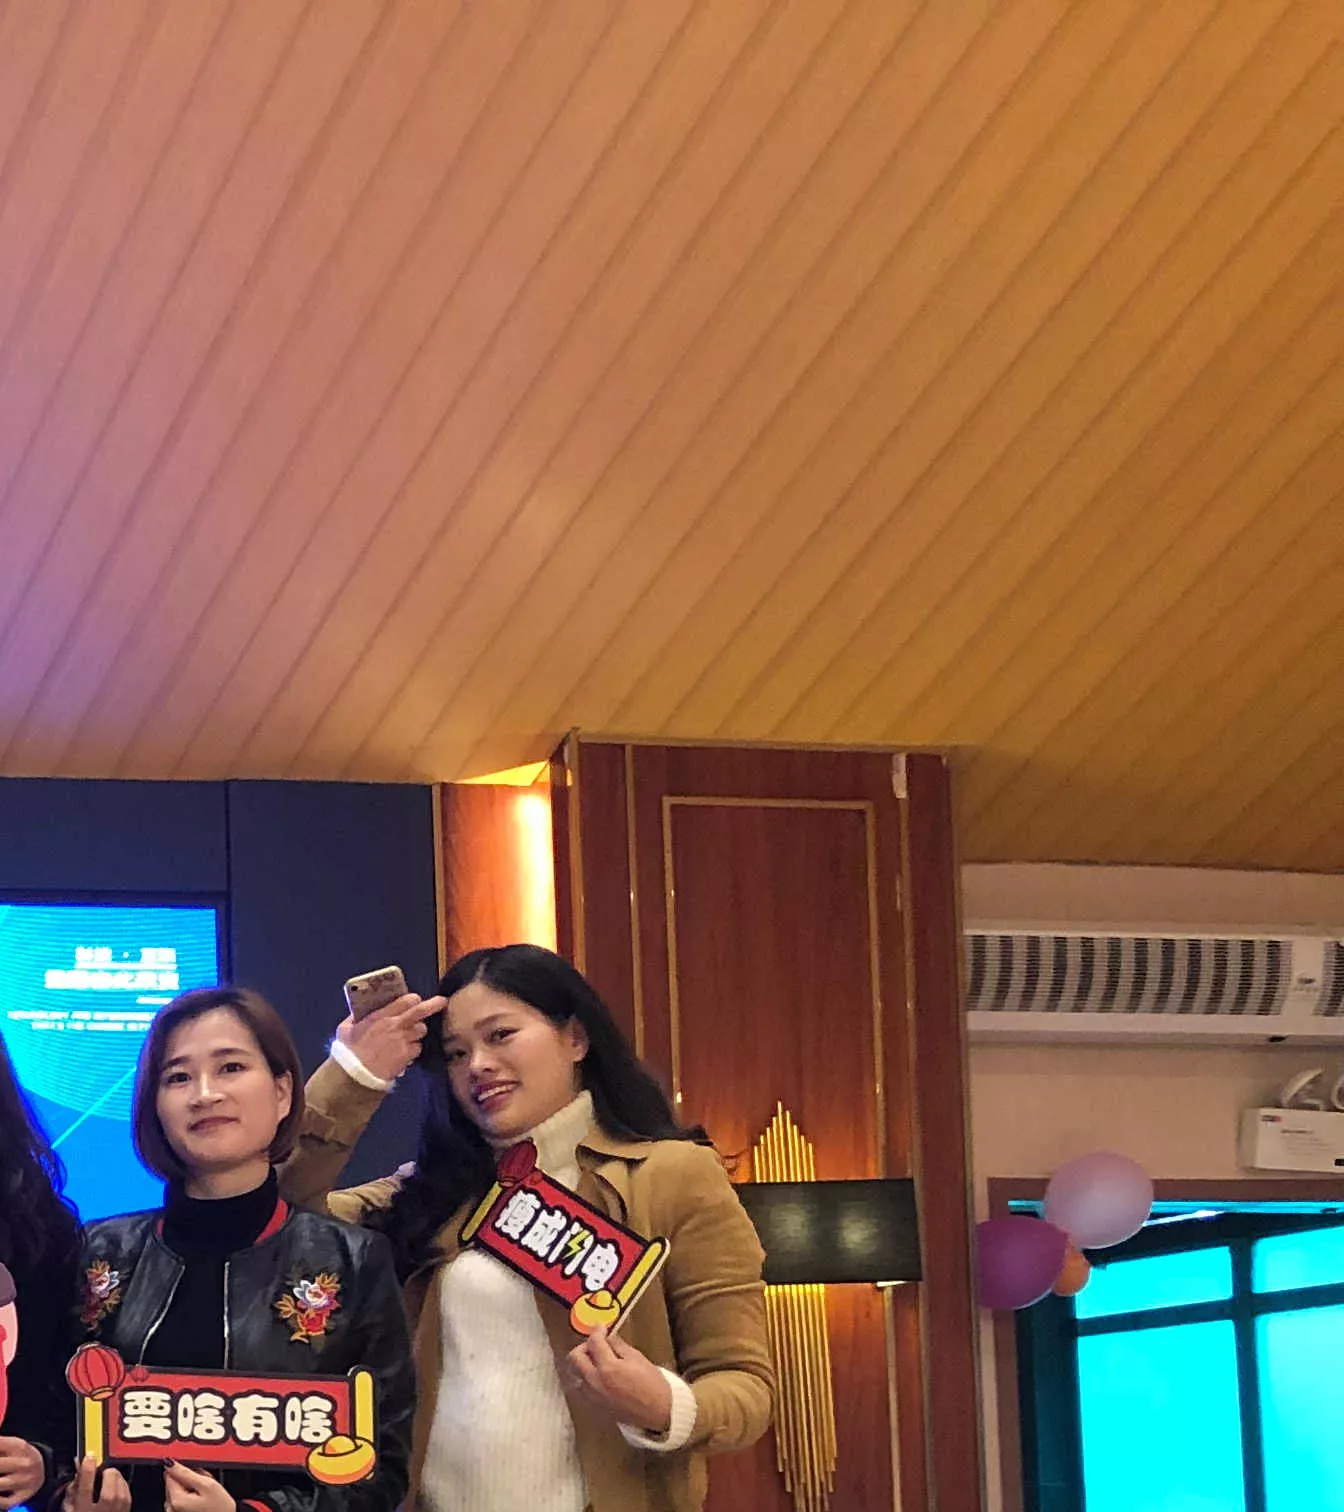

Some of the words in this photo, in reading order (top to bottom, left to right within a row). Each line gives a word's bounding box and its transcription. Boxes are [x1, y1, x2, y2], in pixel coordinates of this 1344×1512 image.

[495, 1190, 619, 1292] 瘦成闪电
[123, 1390, 333, 1444] 要啥有啥
